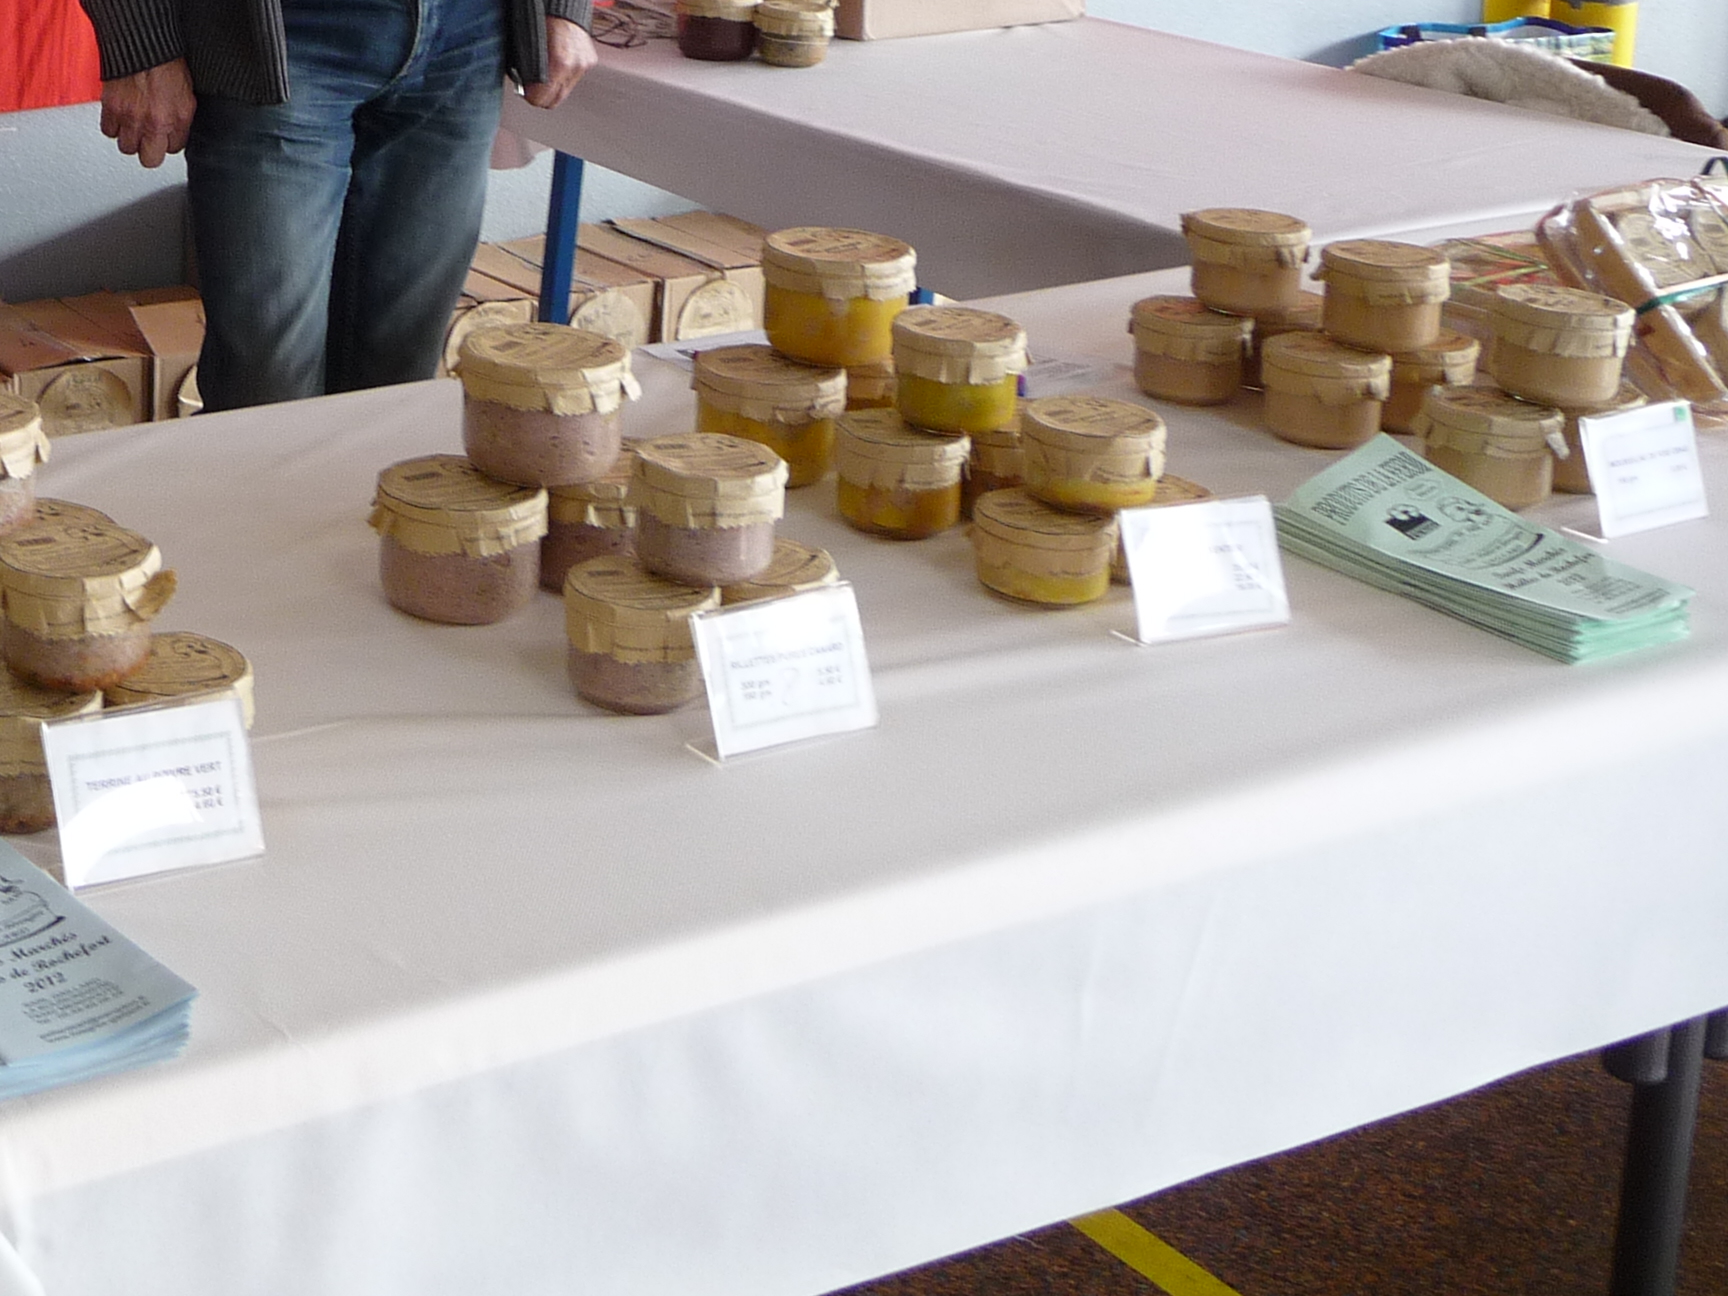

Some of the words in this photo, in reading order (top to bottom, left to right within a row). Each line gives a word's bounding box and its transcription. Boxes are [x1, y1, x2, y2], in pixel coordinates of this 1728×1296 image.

[85, 772, 132, 791] TERRINE
[193, 760, 222, 774] VERT
[9, 967, 29, 980] de
[29, 935, 112, 973] Rochefort
[22, 970, 68, 994] 2012
